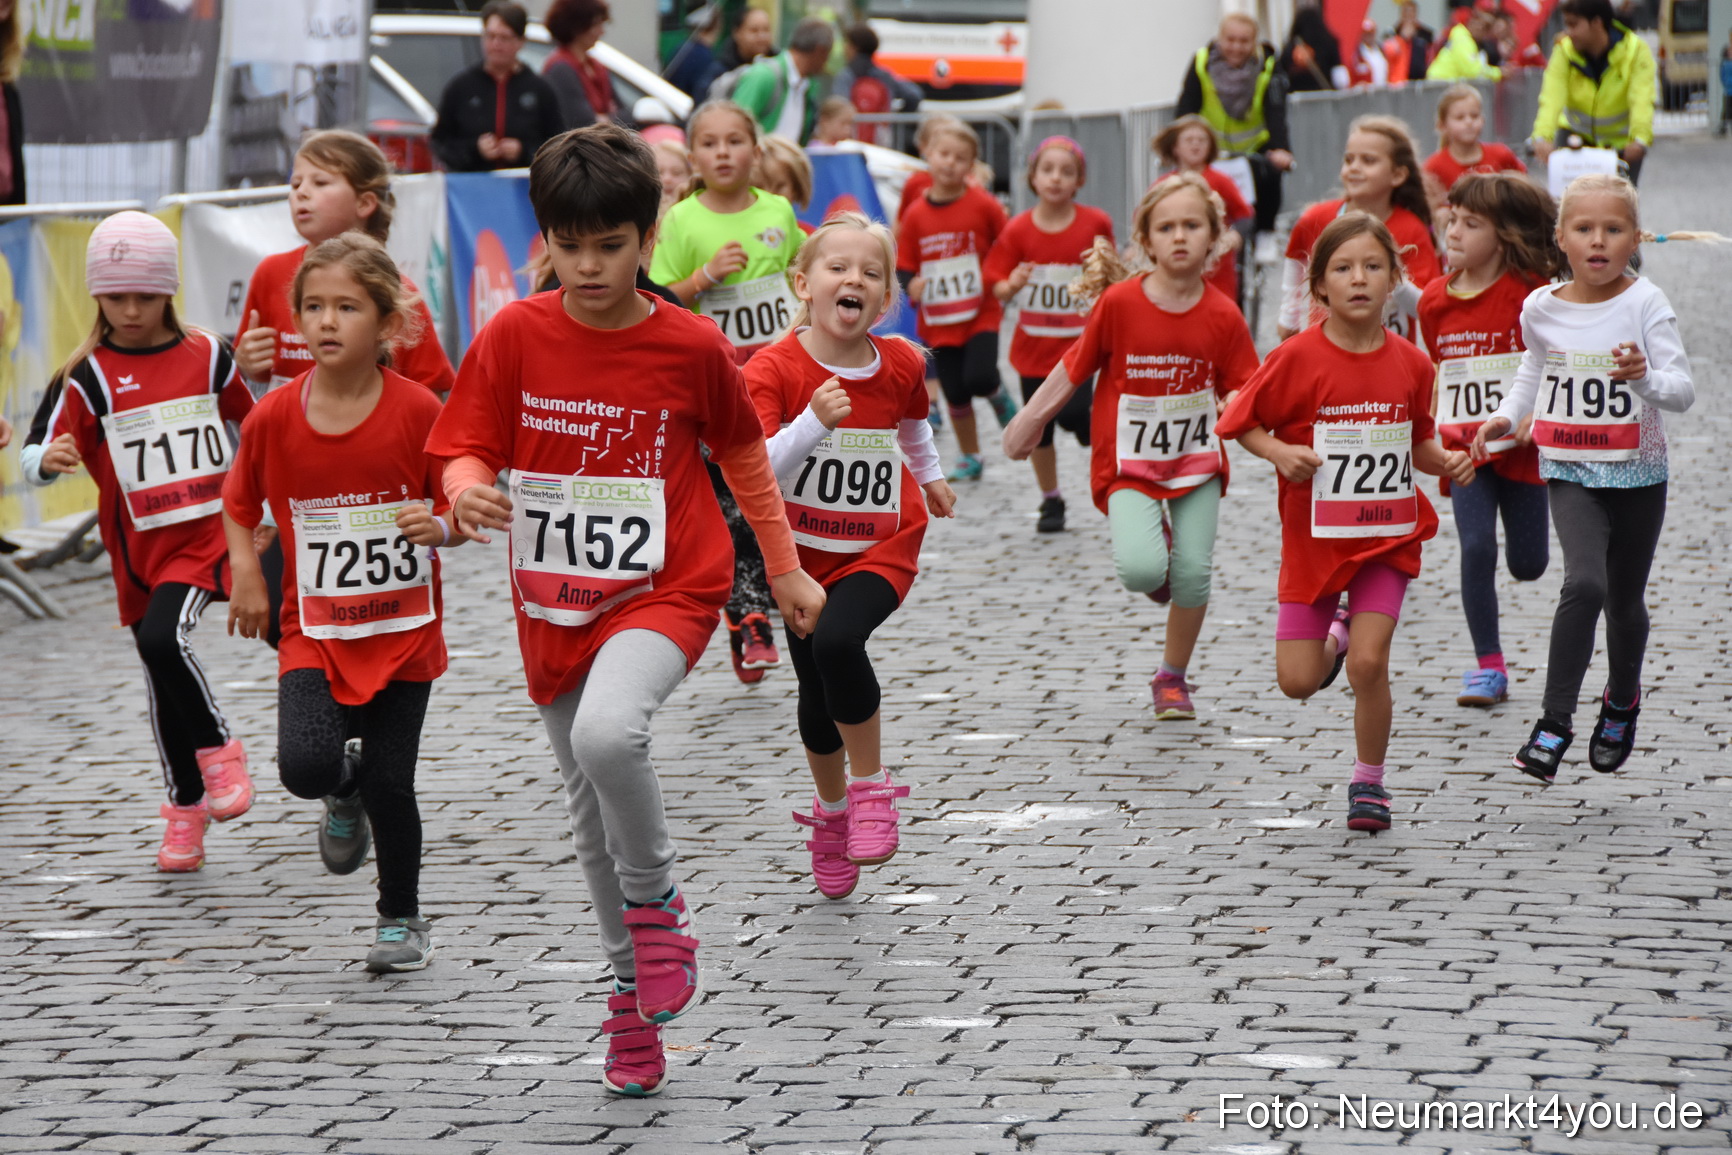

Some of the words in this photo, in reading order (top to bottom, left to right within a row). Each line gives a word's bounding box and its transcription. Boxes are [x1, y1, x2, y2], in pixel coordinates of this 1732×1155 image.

[712, 297, 790, 341] 7006
[1126, 353, 1191, 365] Neumarkter
[1573, 353, 1618, 368] BOC
[1126, 366, 1178, 380] Stadtlauf
[116, 383, 141, 394] erima
[1447, 380, 1503, 418] 705
[1546, 375, 1632, 419] 7195
[522, 390, 625, 419] Neumarkter
[522, 412, 601, 441] Stadtlauf
[1129, 413, 1210, 455] 7474
[1370, 426, 1409, 443] BOC
[1553, 428, 1609, 446] Madlen
[653, 409, 669, 479] BAMBI
[841, 433, 893, 449] BOCK
[123, 424, 224, 483] 7170
[793, 455, 893, 506] 7098
[1327, 450, 1412, 494] 7224
[288, 492, 372, 511] Neumarkter
[521, 487, 564, 500] NeuerMarkt
[572, 482, 652, 502] BOCK
[349, 506, 403, 528] BOC
[891, 502, 897, 511] K
[1356, 506, 1393, 523] Julia
[303, 524, 342, 532] NeuerMarkt
[797, 511, 875, 536] Annalena
[525, 508, 651, 571] 7152
[307, 533, 418, 589] 7253
[518, 558, 524, 568] 3
[556, 582, 603, 605] Anna
[330, 599, 400, 621] Josefine
